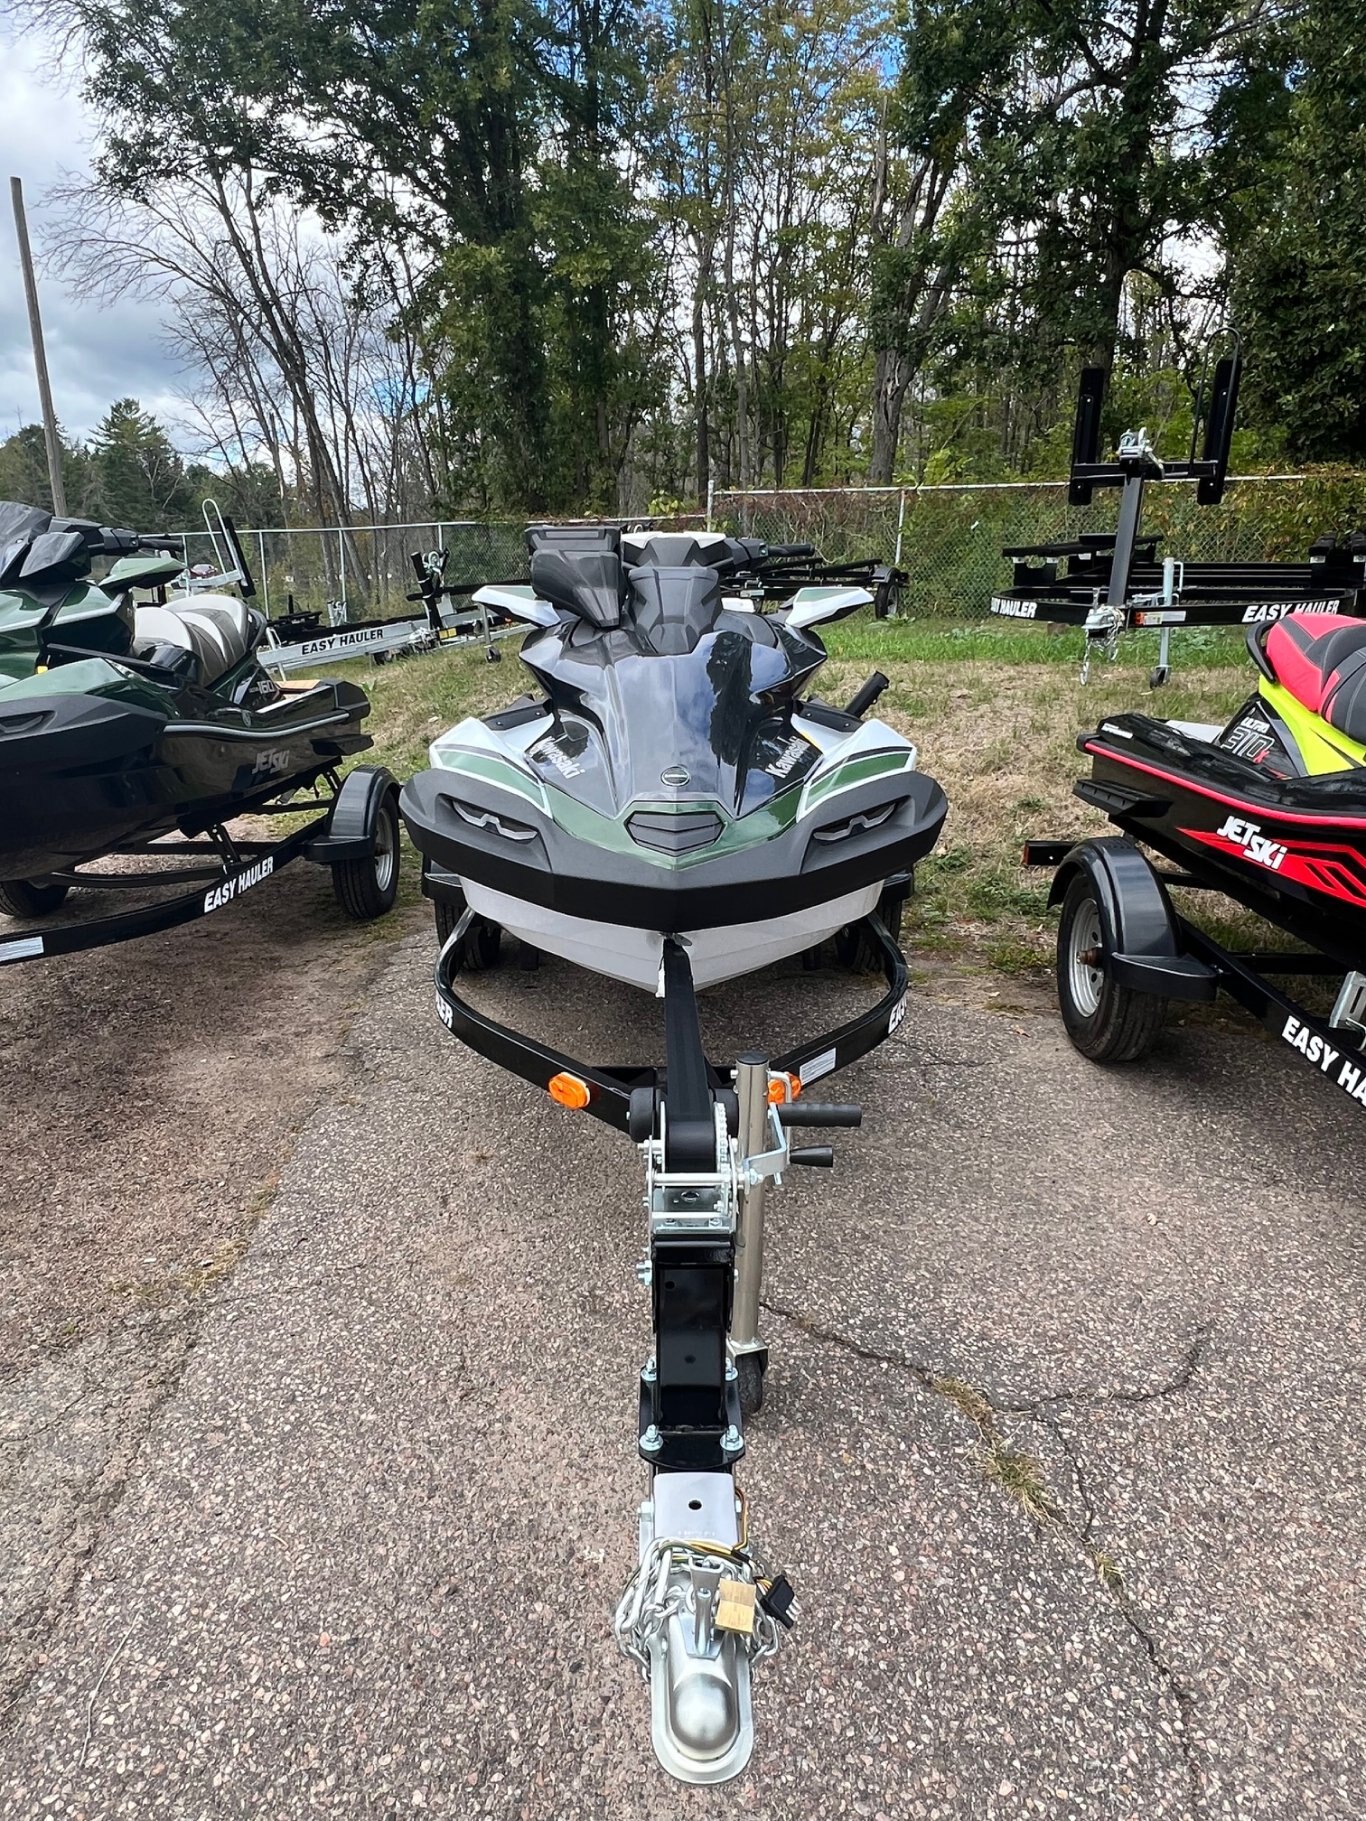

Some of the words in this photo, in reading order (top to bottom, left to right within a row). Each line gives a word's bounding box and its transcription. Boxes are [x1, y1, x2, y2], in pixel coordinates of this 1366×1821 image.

[1000, 599, 1037, 618] HAULER
[1241, 603, 1293, 623] EASY
[302, 638, 336, 655] EASY
[339, 629, 384, 647] HAULER
[257, 680, 276, 694] 160
[204, 878, 237, 913] EASY
[238, 856, 274, 894] HAULER
[1281, 1015, 1340, 1072] EASY
